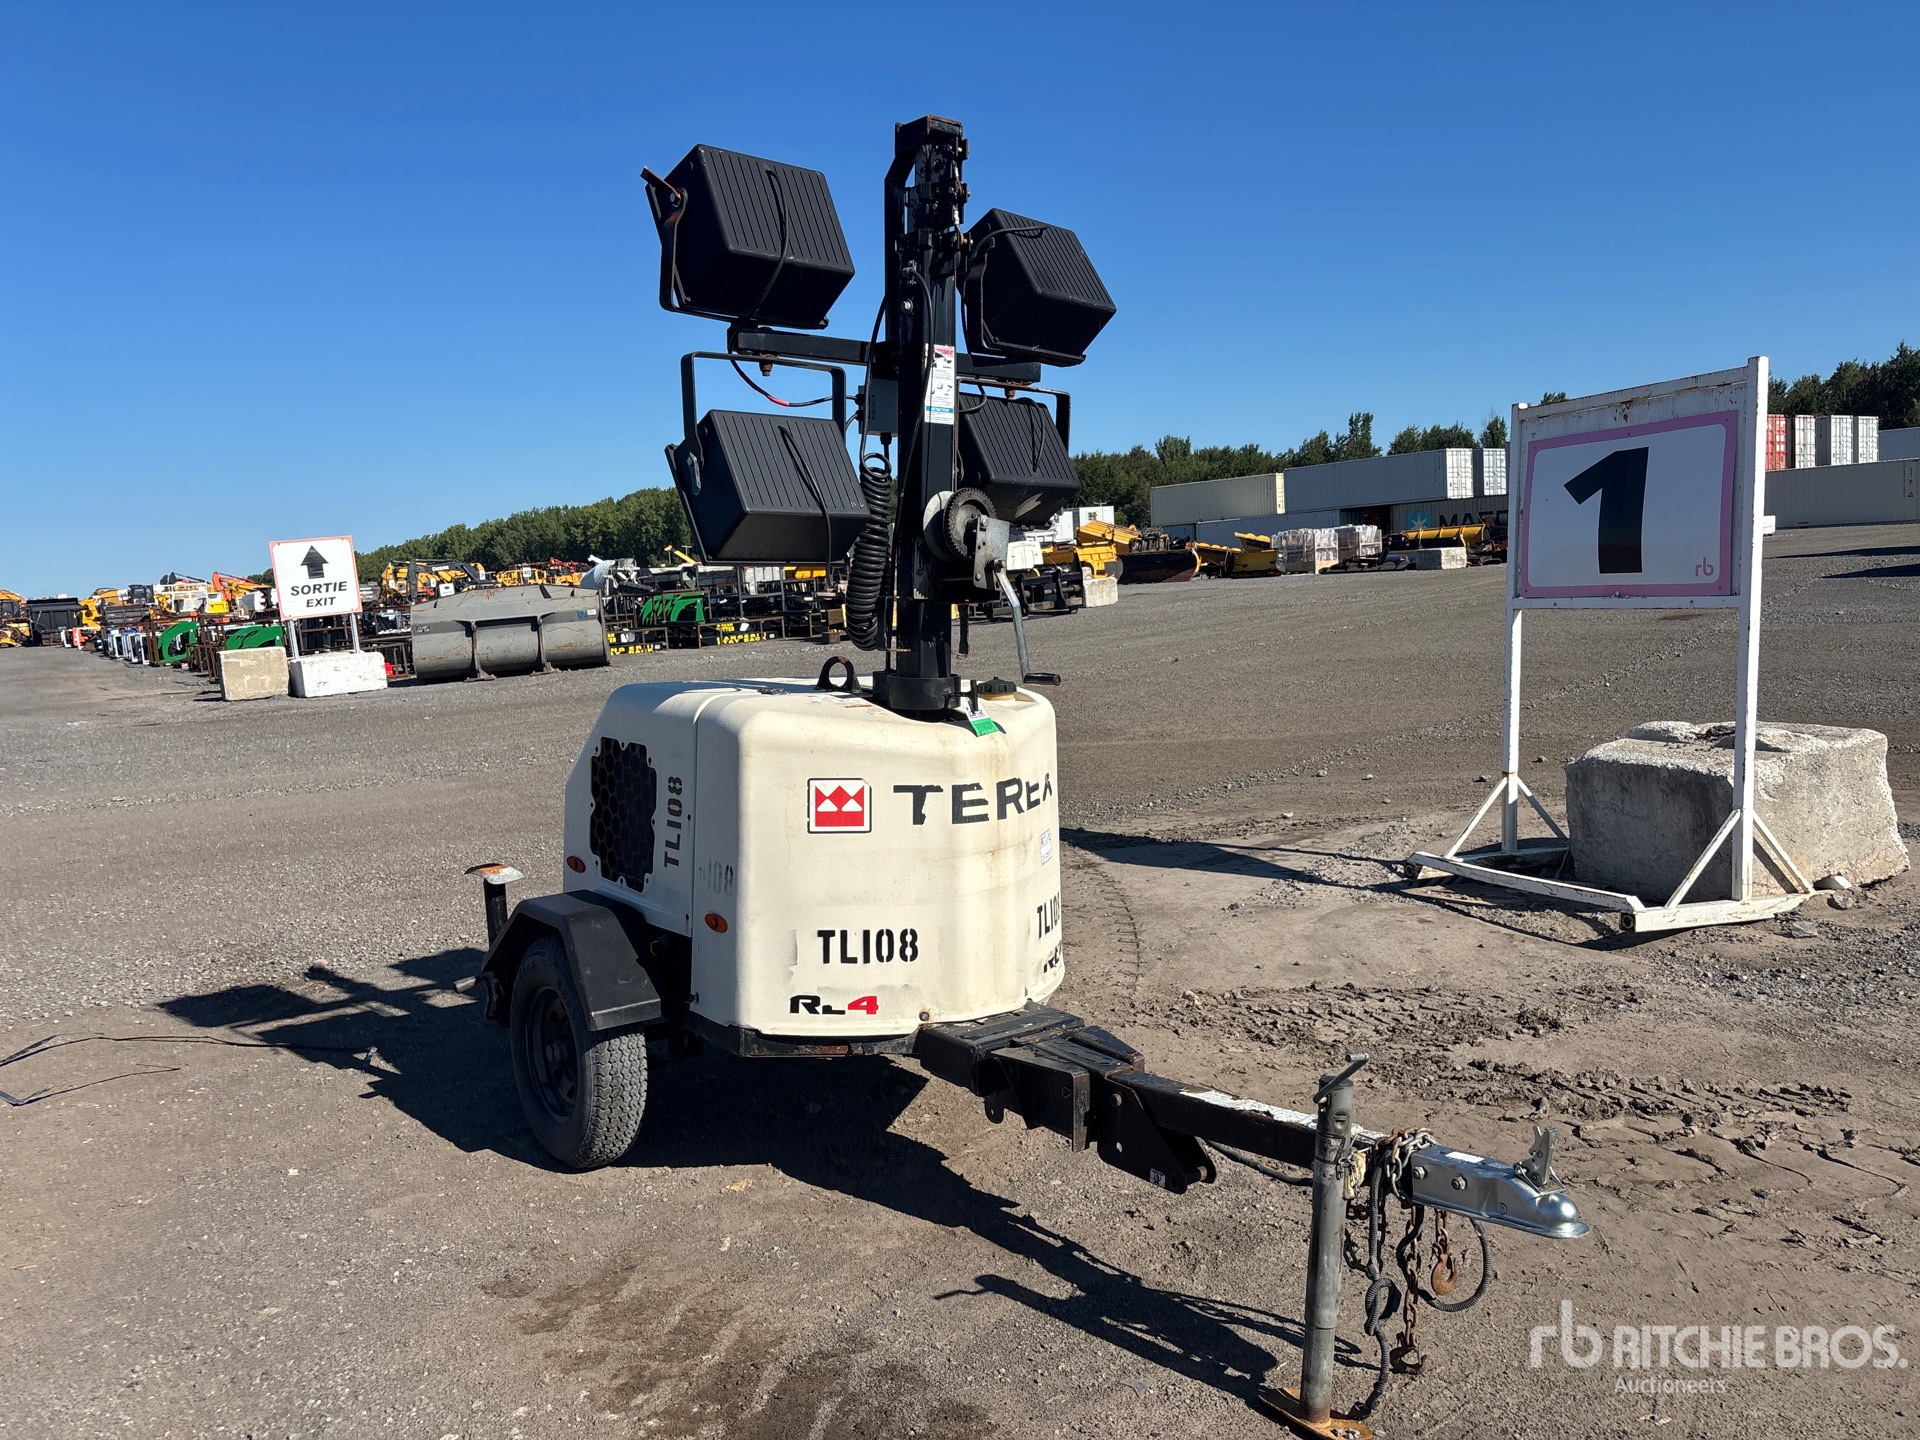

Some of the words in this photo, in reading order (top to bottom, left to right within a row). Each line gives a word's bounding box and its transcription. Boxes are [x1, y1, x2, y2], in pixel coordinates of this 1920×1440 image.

[1563, 446, 1649, 574] 1
[1695, 557, 1714, 576] rb
[290, 581, 347, 596] SORTIE
[306, 596, 336, 608] EXIT
[664, 776, 683, 868] TL108
[817, 928, 919, 964] TL108
[789, 994, 879, 1014] RL4
